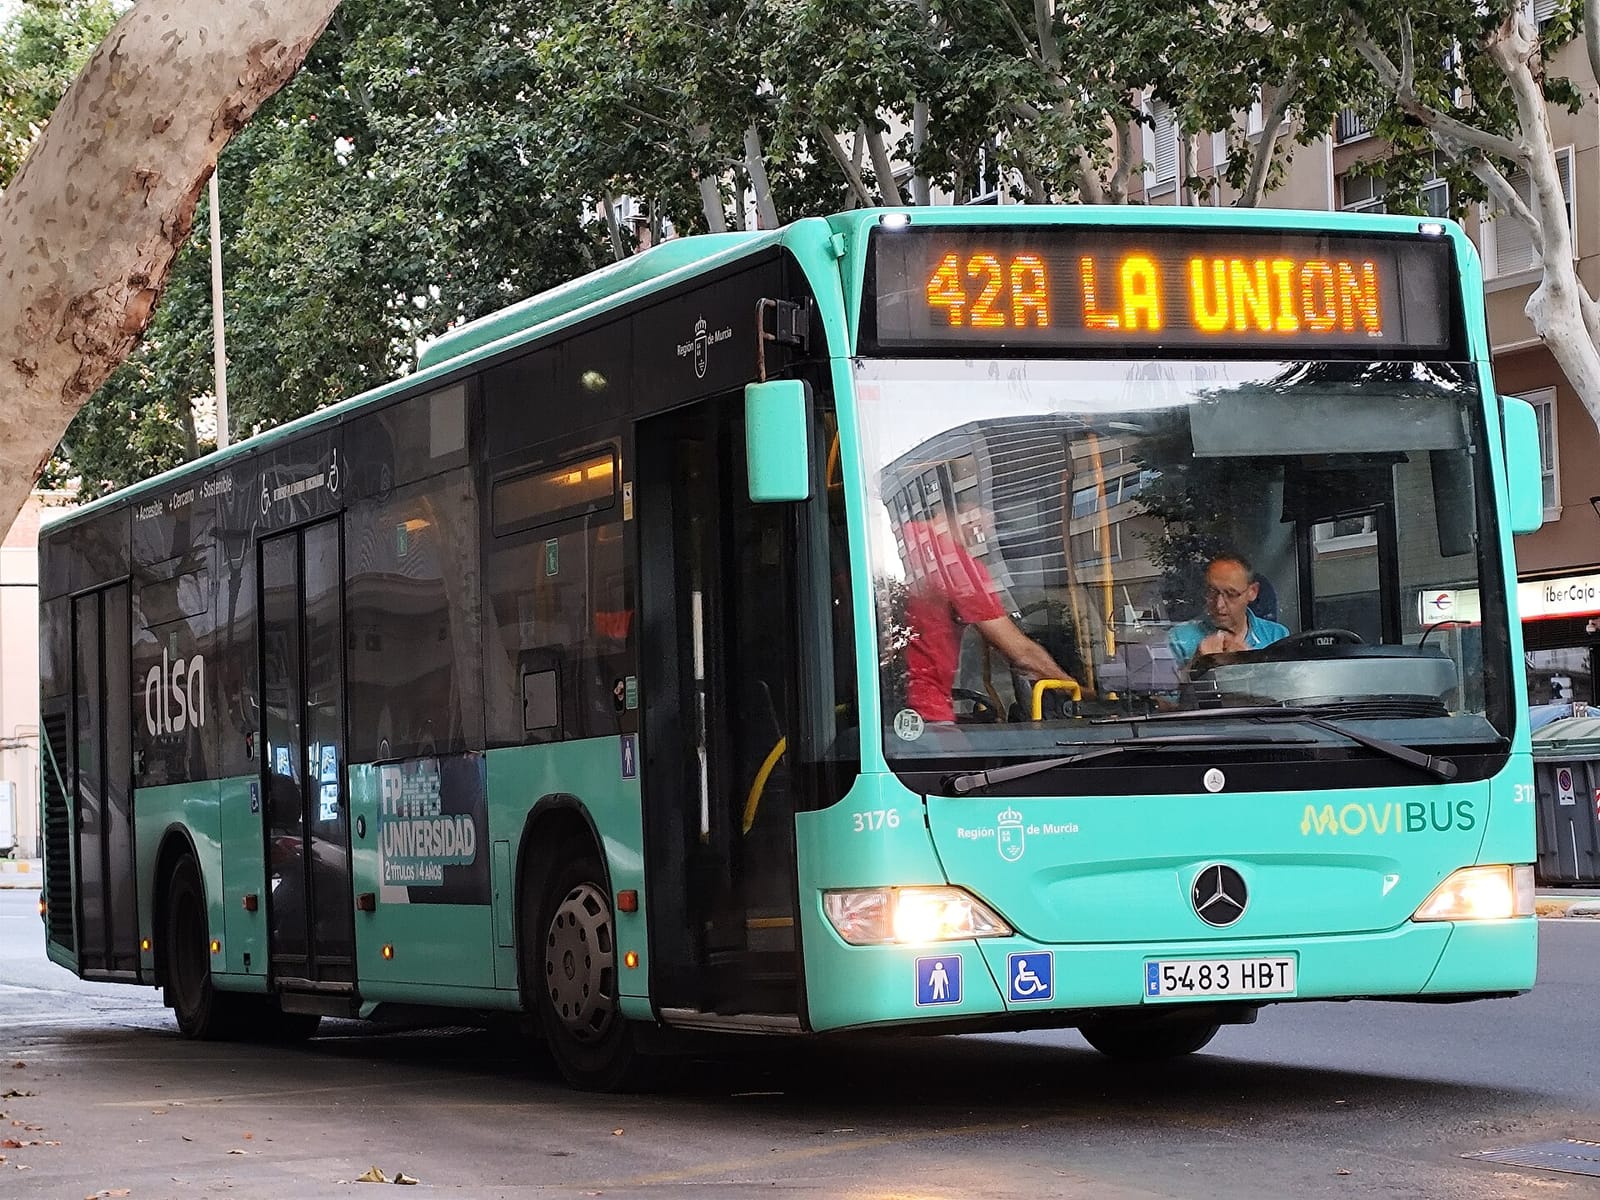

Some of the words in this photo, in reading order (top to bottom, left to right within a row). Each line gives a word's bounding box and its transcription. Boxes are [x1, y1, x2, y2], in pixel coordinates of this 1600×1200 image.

[925, 252, 1049, 328] 42A
[1080, 250, 1162, 331] LA
[1190, 256, 1382, 332] UNION
[145, 646, 205, 736] alsa
[852, 808, 900, 832] 3176
[957, 826, 995, 841] Región
[1026, 823, 1040, 835] de
[1043, 822, 1079, 835] Murcia
[1300, 800, 1477, 836] MOVIBUS
[384, 818, 476, 858] UNIVERSIDAD
[1163, 964, 1230, 991] 5483
[1242, 962, 1289, 989] HBT
